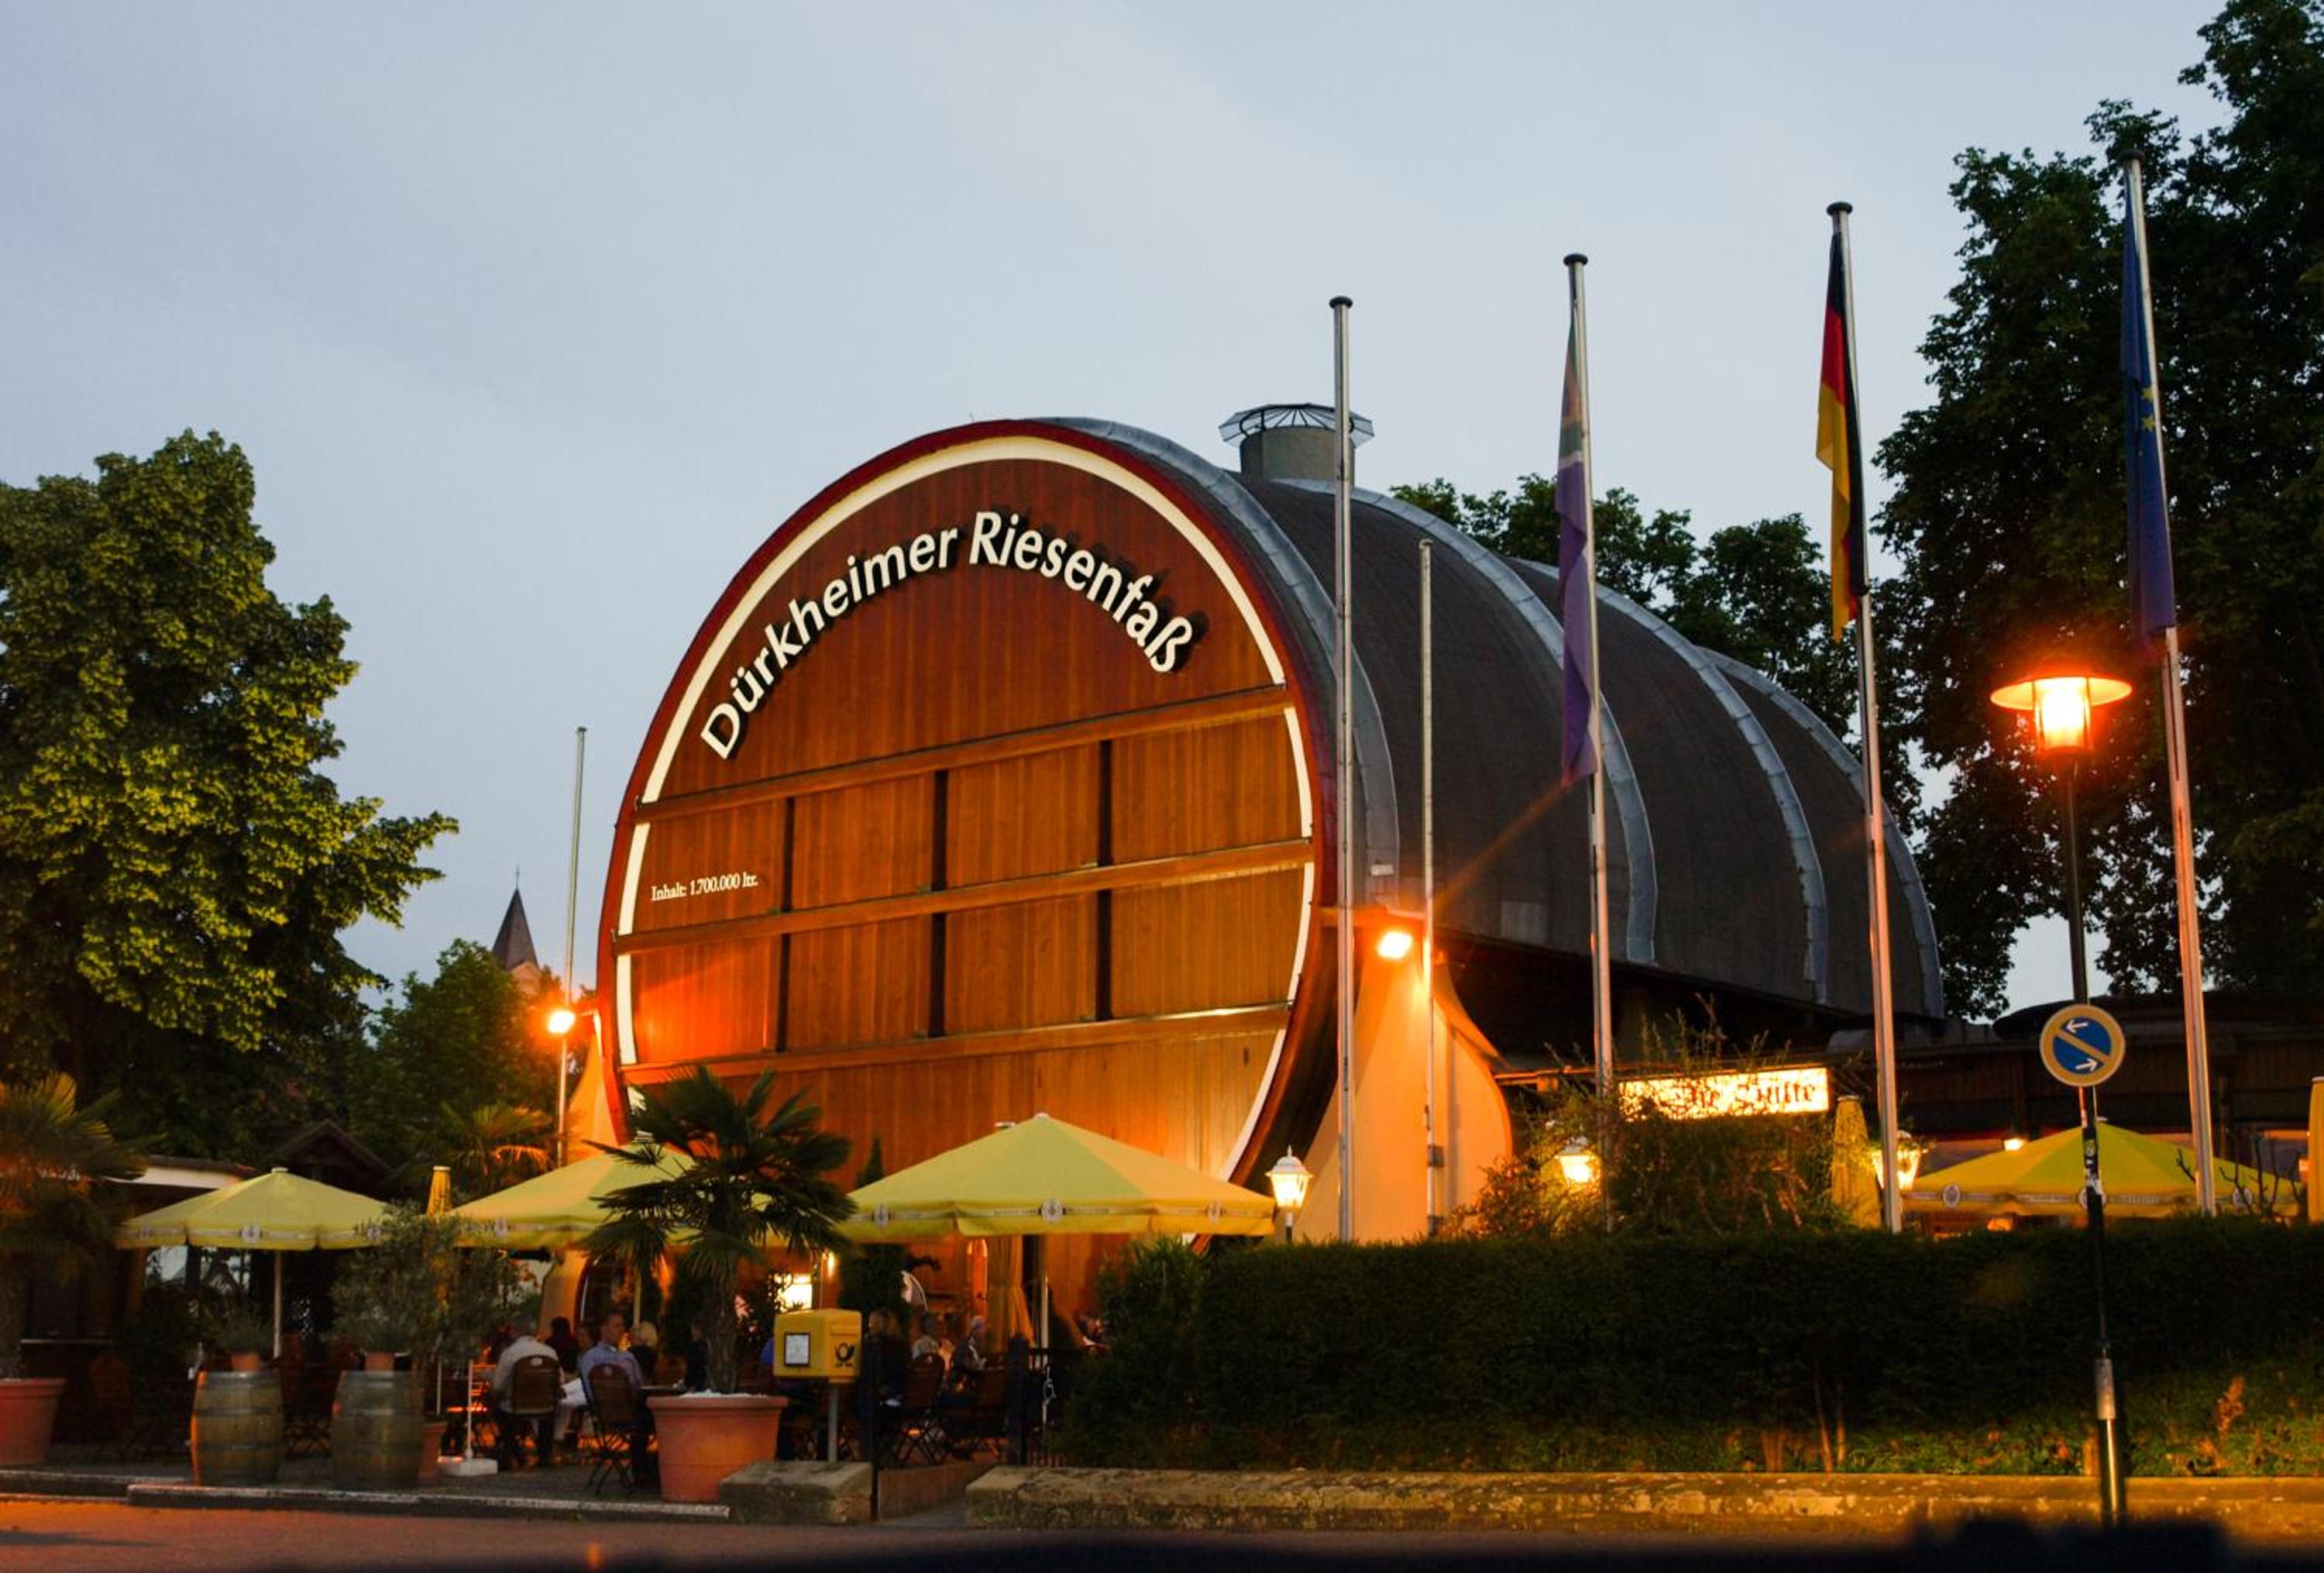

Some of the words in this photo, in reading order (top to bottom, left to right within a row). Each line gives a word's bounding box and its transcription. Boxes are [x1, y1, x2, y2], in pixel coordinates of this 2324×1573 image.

[700, 527, 958, 759] Dürkheimer
[969, 511, 1194, 673] Riesenfaß
[651, 882, 686, 901] Inhalt:
[690, 873, 740, 896] 1.700.000
